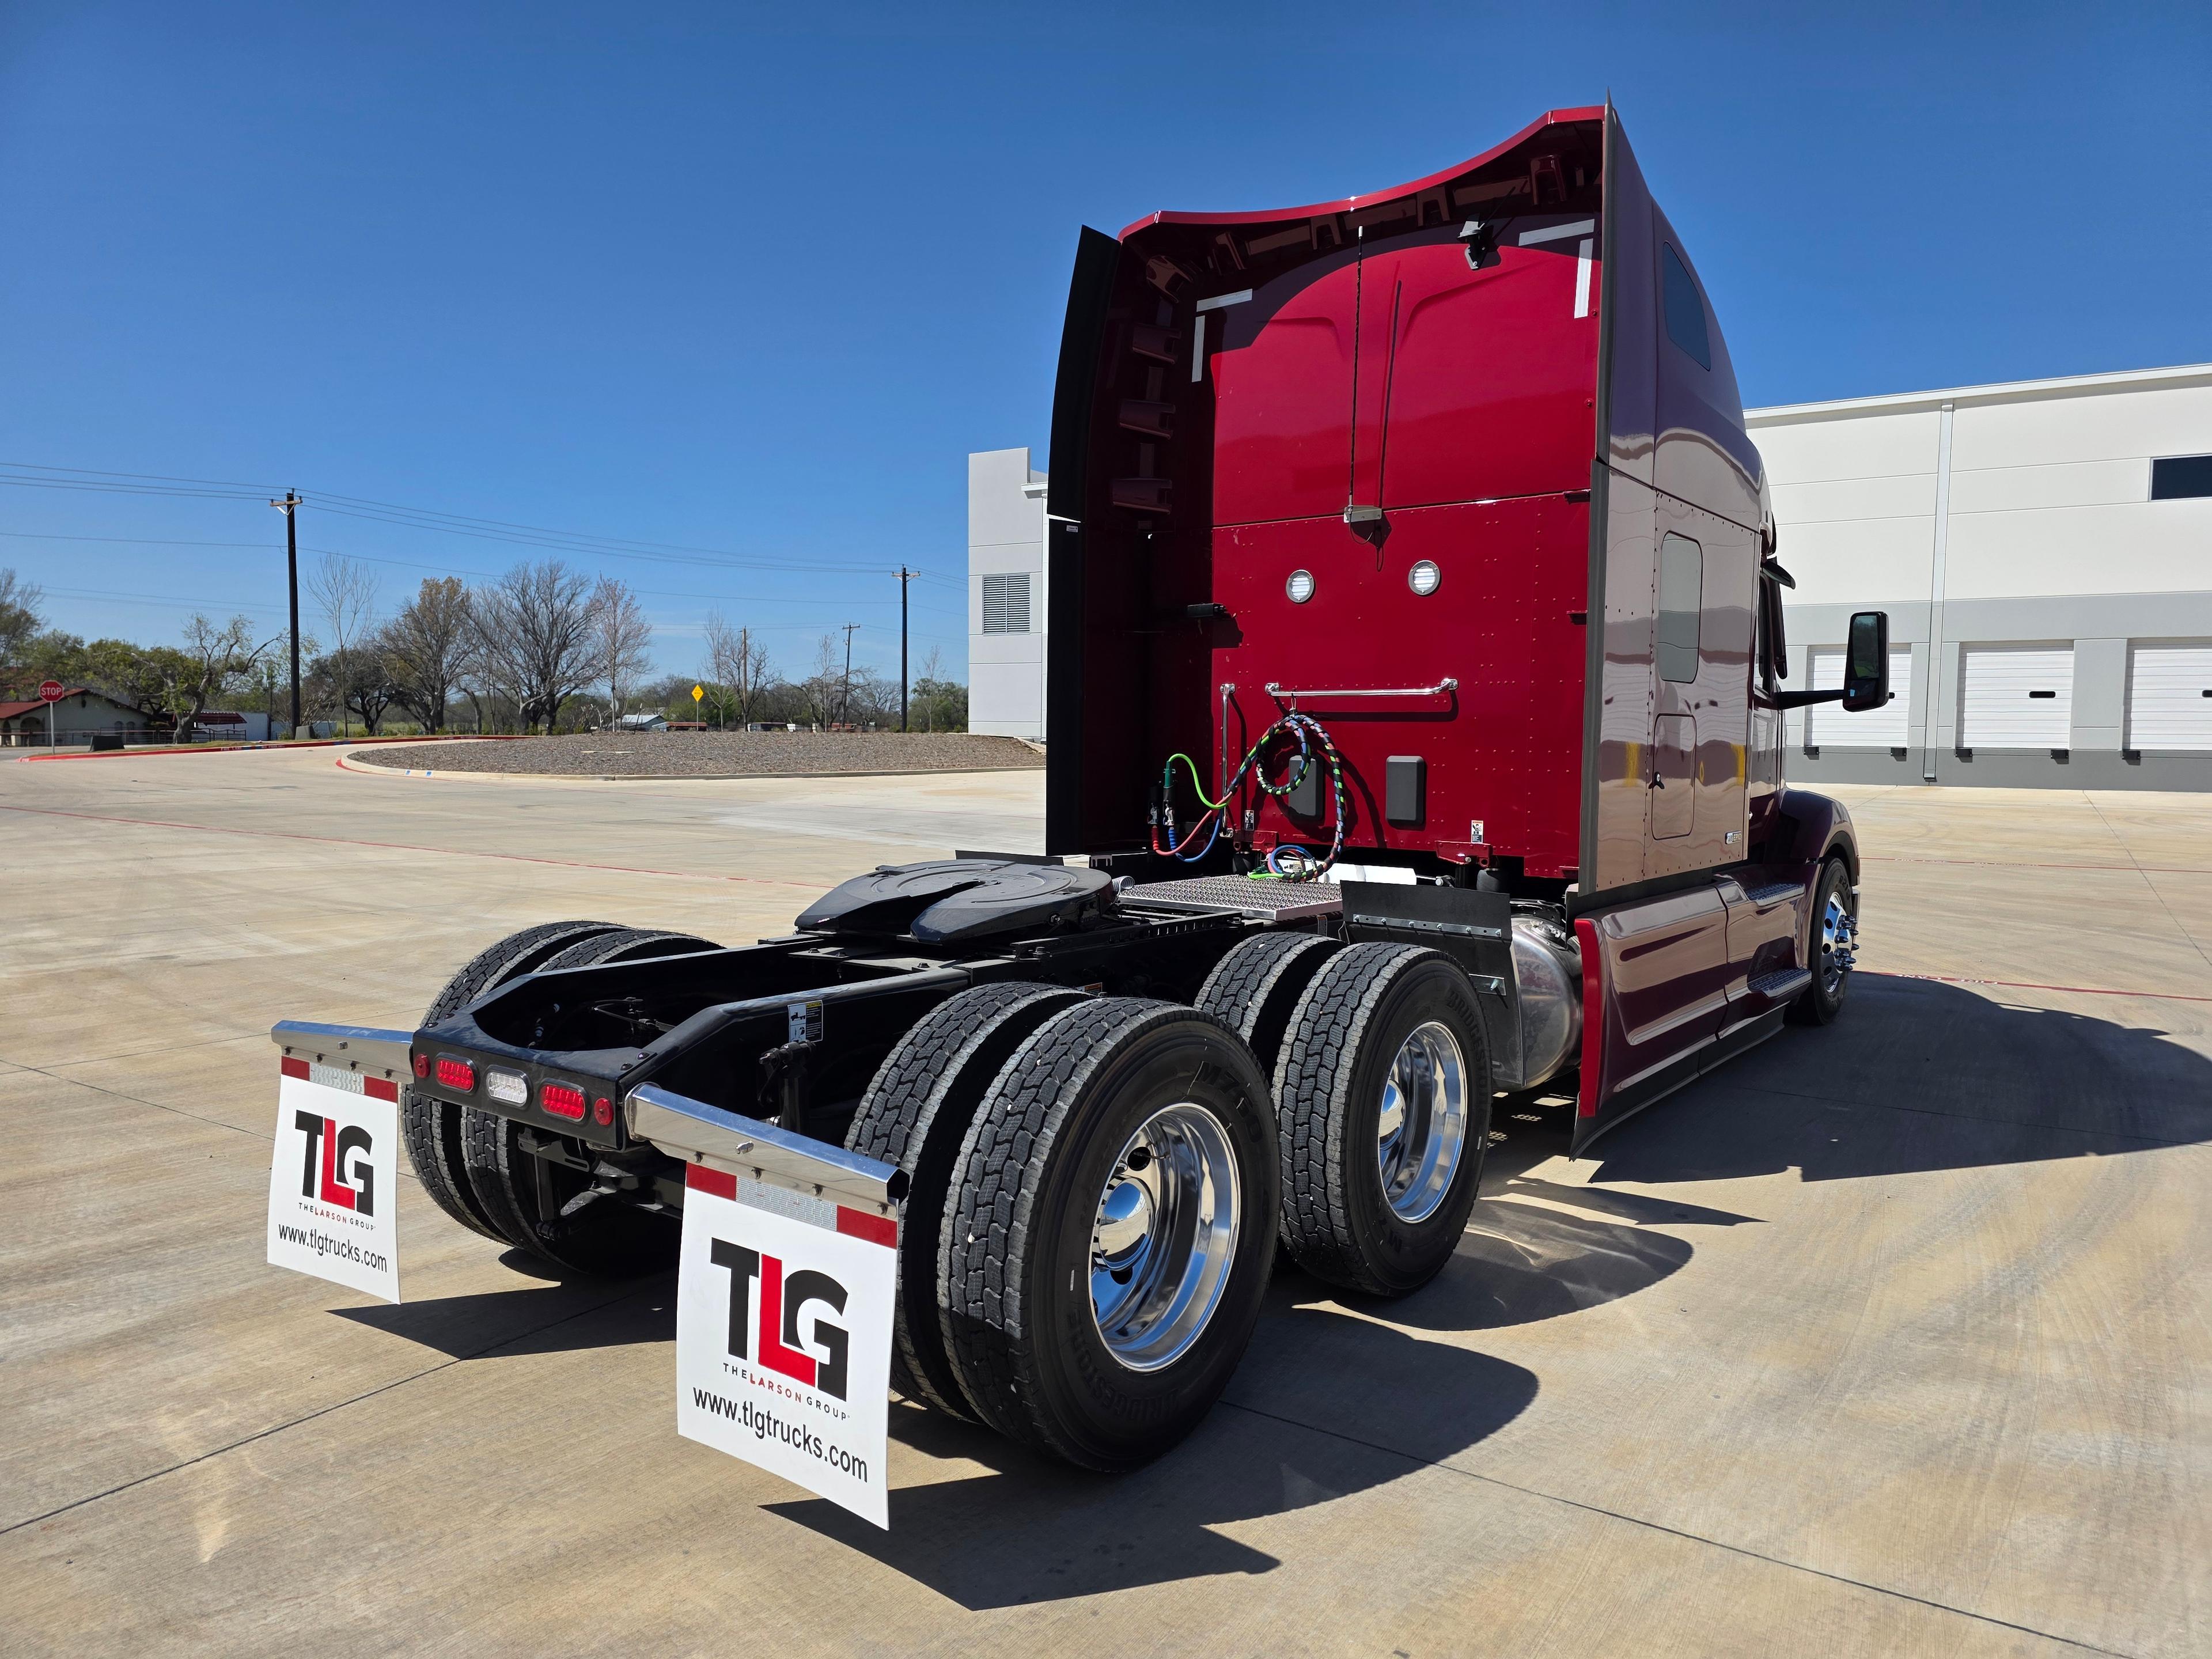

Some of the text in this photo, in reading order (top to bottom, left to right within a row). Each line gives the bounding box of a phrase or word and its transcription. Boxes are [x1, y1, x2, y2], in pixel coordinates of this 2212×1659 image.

[41, 687, 62, 696] STOP
[1446, 990, 1488, 1119] BRIDGESTONE
[296, 1109, 374, 1217] TLG
[278, 1224, 387, 1273] www.tlgtrucks.com
[350, 1218, 374, 1231] GROUP
[711, 1237, 849, 1402] TLG
[693, 1387, 868, 1483] www.tlgtrucks.com
[806, 1396, 846, 1421] GROUP
